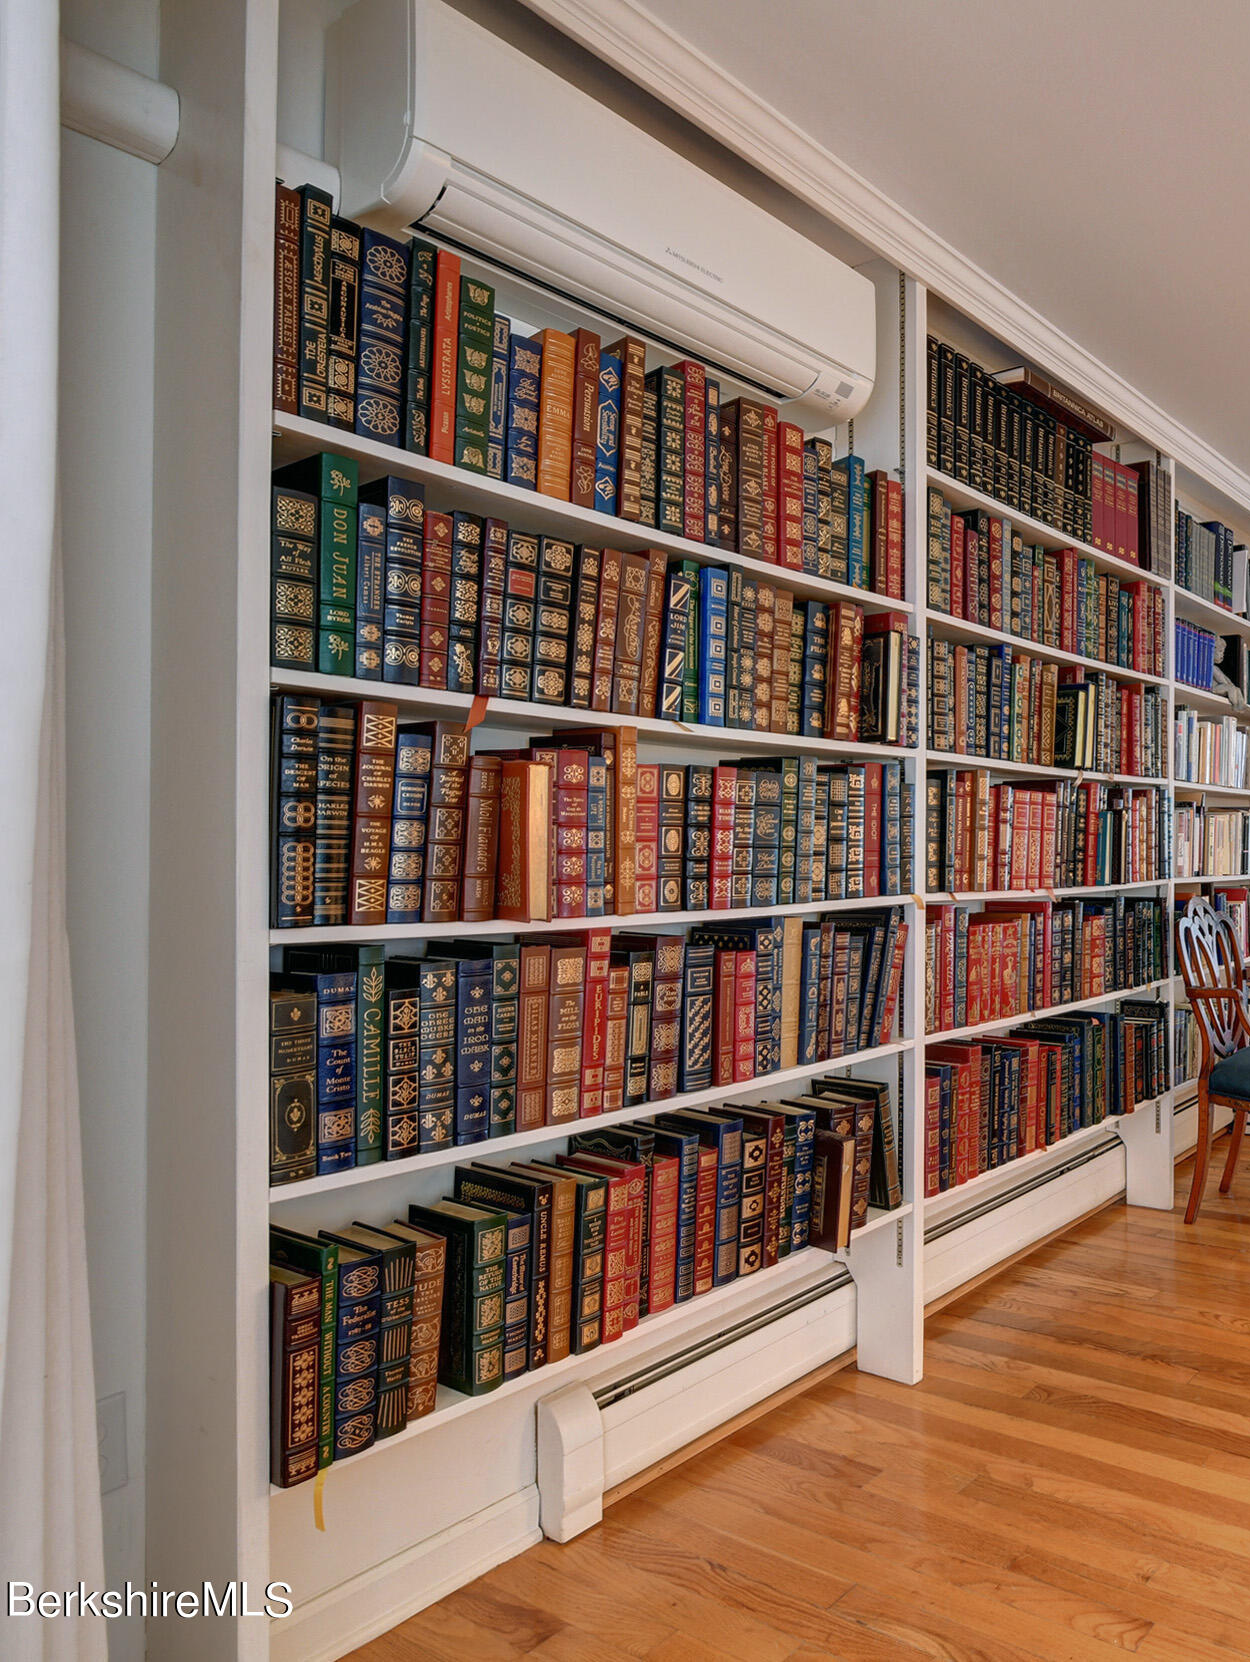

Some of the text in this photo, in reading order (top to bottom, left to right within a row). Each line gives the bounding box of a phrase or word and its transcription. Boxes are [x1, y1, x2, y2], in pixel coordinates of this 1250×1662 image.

[283, 302, 292, 343] FABLES
[441, 337, 452, 396] LYSISTRATA
[546, 404, 571, 419] EMMA
[584, 382, 594, 432] Persuasion
[1052, 388, 1104, 428] BRITANNICA ATLAS
[333, 508, 348, 544] DON
[280, 540, 313, 554] The Way
[281, 564, 309, 574] BUTLER
[332, 552, 350, 600] JUAN
[374, 552, 382, 610] THE STRANGER
[326, 614, 350, 624] BYRON
[328, 610, 350, 618] LORD
[670, 613, 687, 622] LORD
[670, 622, 686, 630] JIM
[320, 755, 348, 763] On the
[284, 768, 316, 777] DESCENT
[362, 764, 392, 772] JOURNAL
[328, 772, 338, 780] of
[362, 775, 392, 784] CHARLES
[440, 774, 464, 784] Journal
[402, 792, 423, 800] CRUSOE
[360, 826, 387, 834] VOYAGE
[476, 800, 492, 872] Moll Flanders
[323, 986, 355, 996] DUMAS
[564, 1000, 576, 1008] The
[560, 1006, 580, 1016] MILL
[557, 1022, 580, 1031] FLOSS
[592, 984, 603, 1060] EURIPIDES
[463, 1034, 489, 1045] IRON
[332, 1049, 348, 1058] The
[363, 1008, 382, 1104] CAMILLE
[326, 1056, 351, 1066] Count
[335, 1066, 344, 1076] of
[326, 1076, 352, 1086] Monte
[326, 1084, 351, 1094] Cristo
[426, 1090, 450, 1100] DUMAS
[464, 1110, 487, 1120] DUMAS
[322, 1154, 339, 1163] Book
[540, 1212, 548, 1240] UNCLE
[484, 1264, 500, 1274] THE
[478, 1268, 504, 1281] RETURN
[414, 1278, 442, 1293] JUDE
[478, 1276, 504, 1286] OF THE
[479, 1282, 502, 1292] NATIVE
[386, 1296, 410, 1311] TESS
[353, 1304, 368, 1314] The
[342, 1310, 378, 1327] Federalist
[480, 1330, 500, 1340] THOMAS
[482, 1334, 500, 1345] HARDY
[321, 1280, 335, 1436] THE MAN WITHOUT A COUNTRY
[384, 1367, 405, 1378] Thomas
[386, 1374, 404, 1384] Hardy
